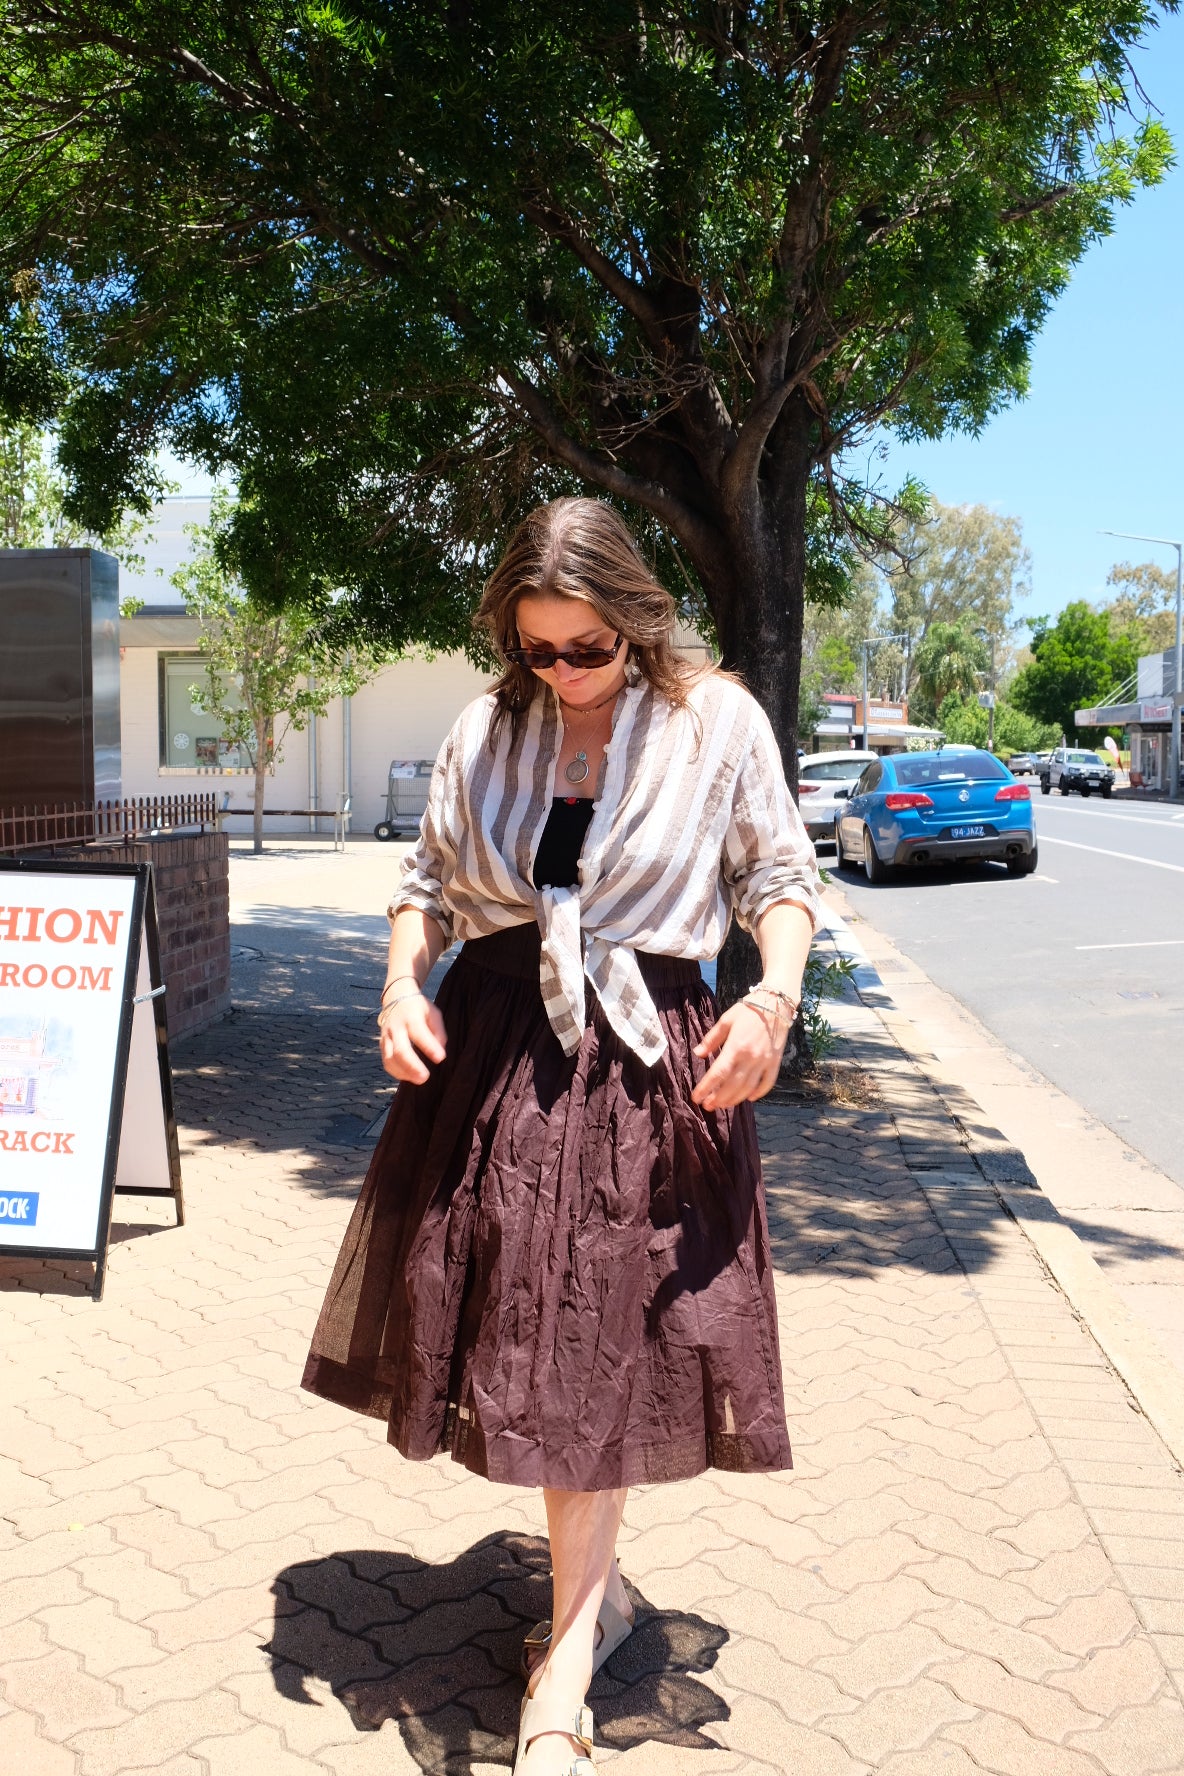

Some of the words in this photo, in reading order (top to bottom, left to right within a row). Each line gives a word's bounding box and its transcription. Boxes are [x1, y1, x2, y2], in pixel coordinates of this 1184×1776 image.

[0, 906, 124, 945] HION
[0, 963, 113, 991] ROOM
[0, 1130, 75, 1154] RACK
